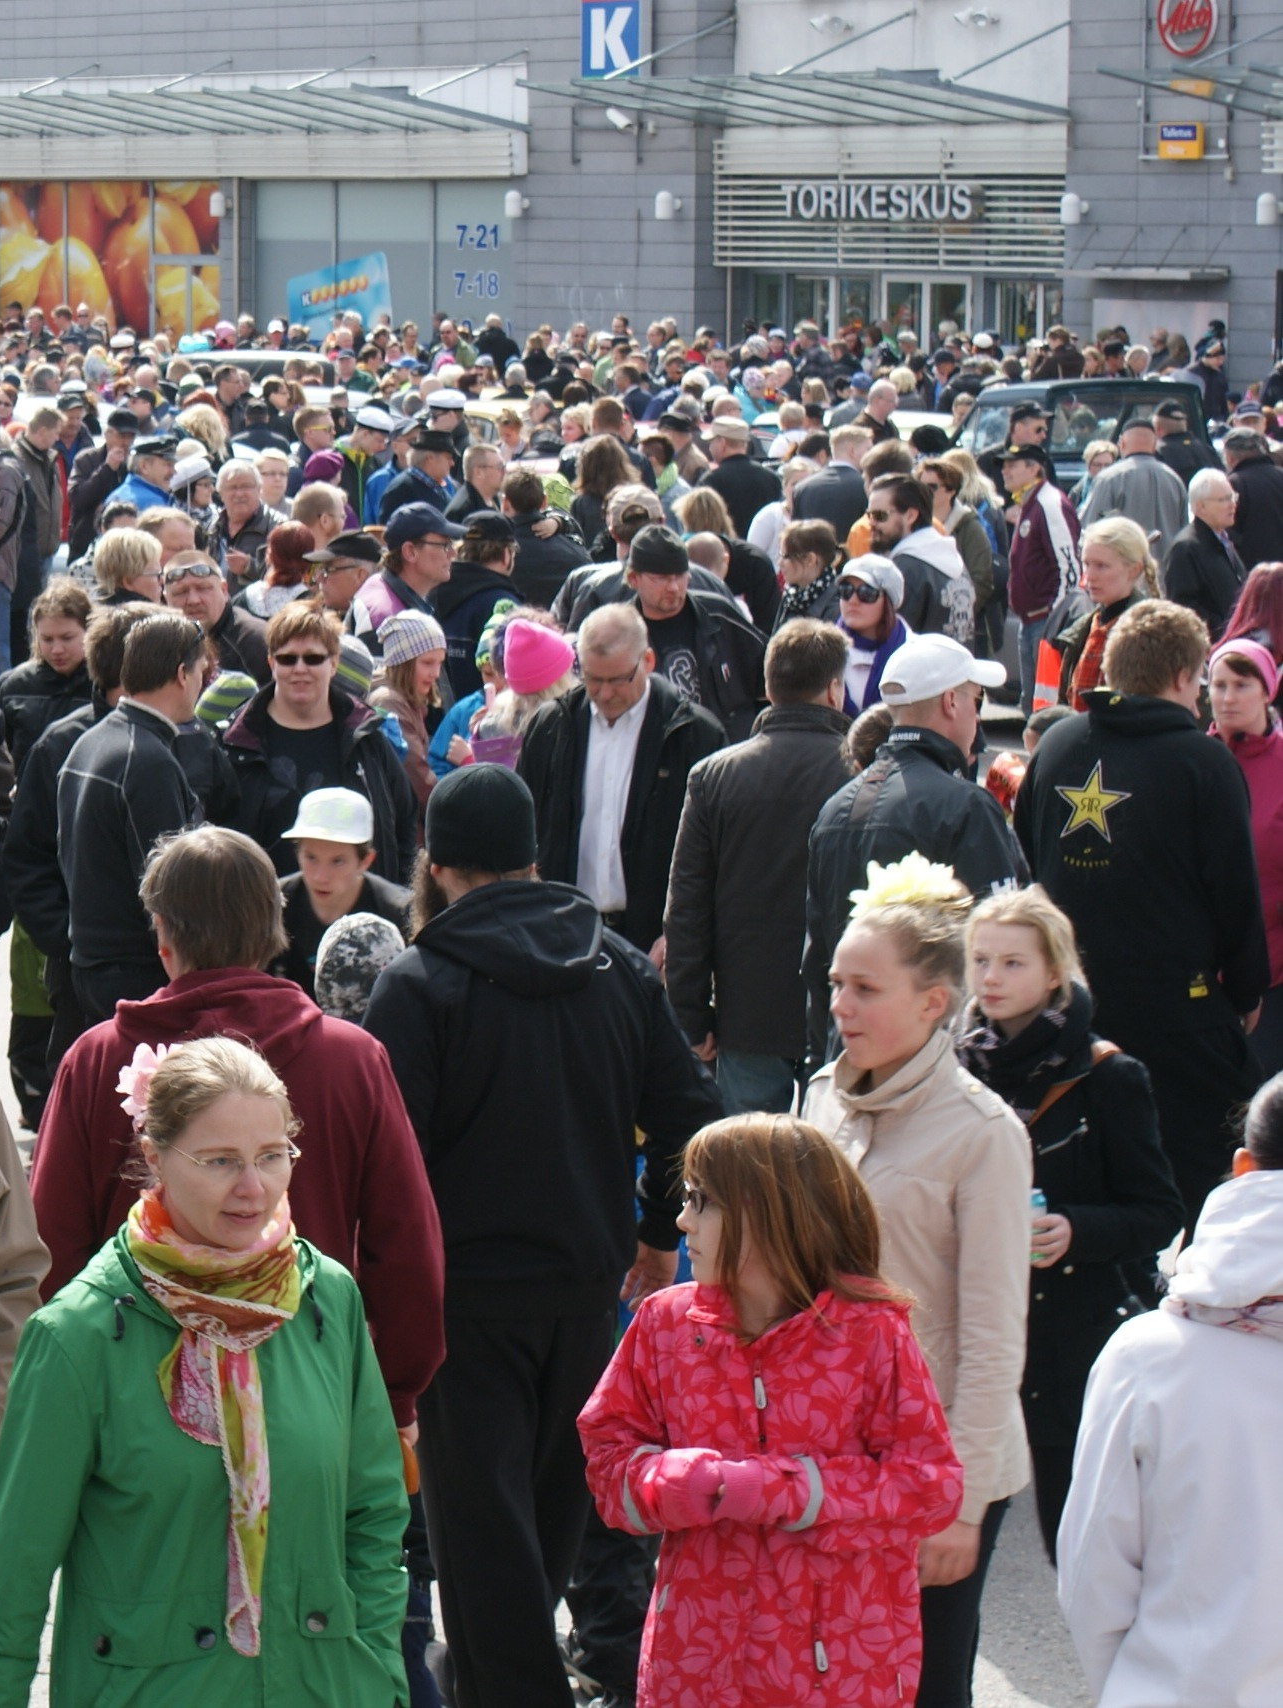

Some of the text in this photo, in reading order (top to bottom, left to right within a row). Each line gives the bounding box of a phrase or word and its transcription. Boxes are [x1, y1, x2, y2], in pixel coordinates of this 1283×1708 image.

[1163, 0, 1212, 35] Alko
[590, 7, 632, 70] K
[781, 184, 972, 220] TORIKESKUS
[456, 223, 500, 249] 7-21
[454, 272, 500, 297] 7-18
